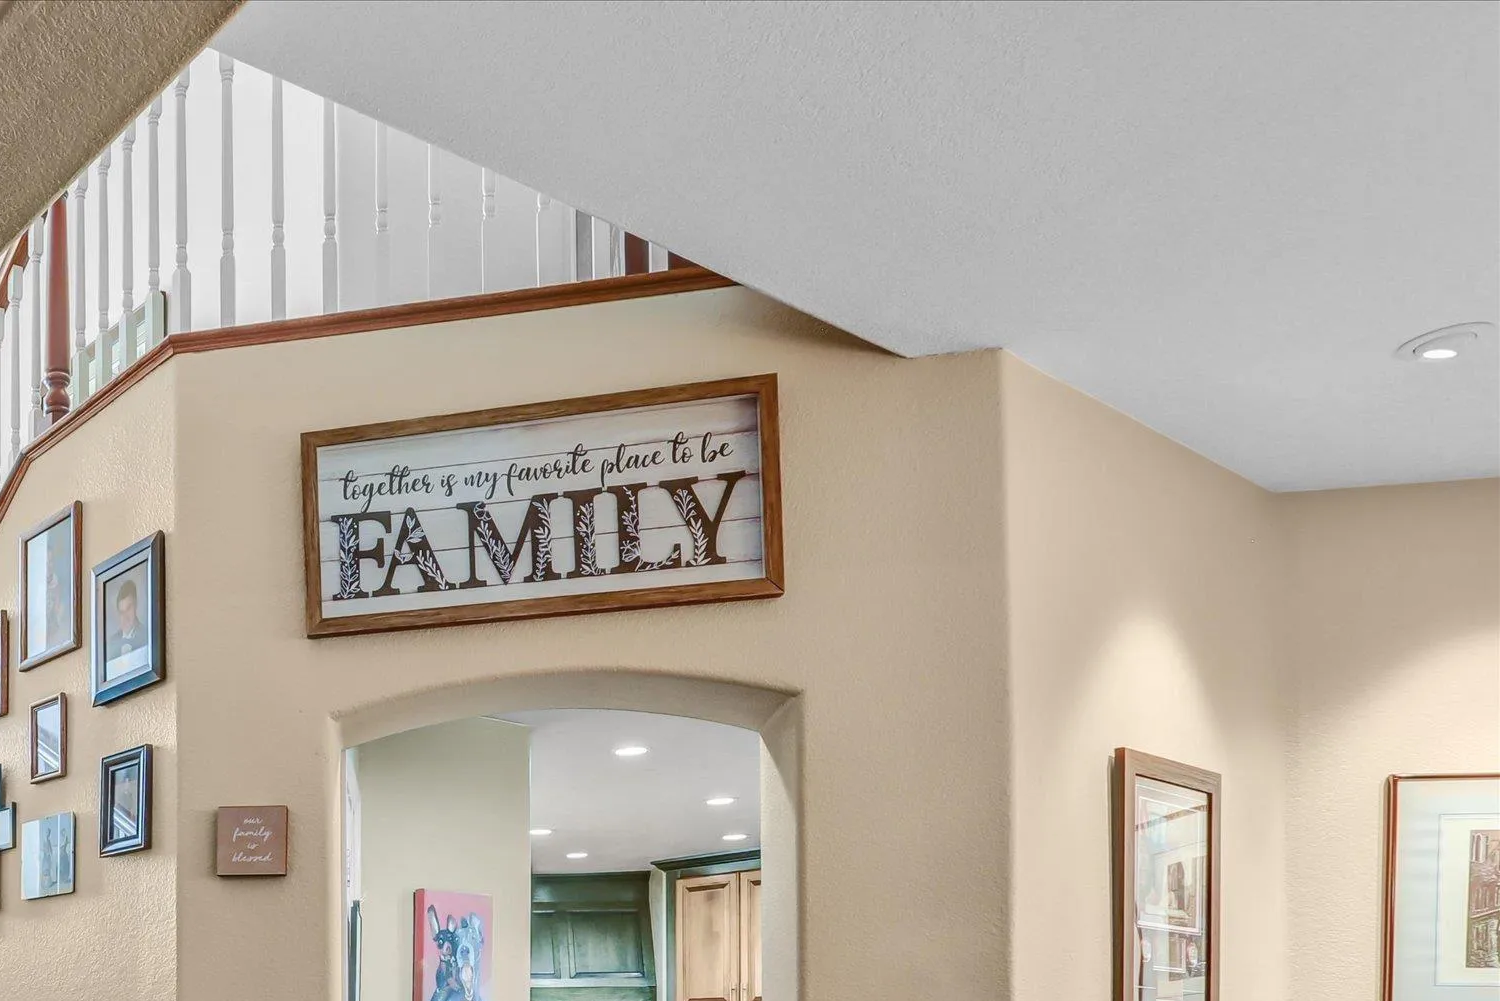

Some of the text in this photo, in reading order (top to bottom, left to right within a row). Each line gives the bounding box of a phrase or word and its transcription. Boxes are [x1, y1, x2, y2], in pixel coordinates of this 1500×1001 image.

[338, 431, 734, 513] together is my favorite place to be
[331, 470, 746, 601] FAMILY
[232, 826, 273, 842] family
